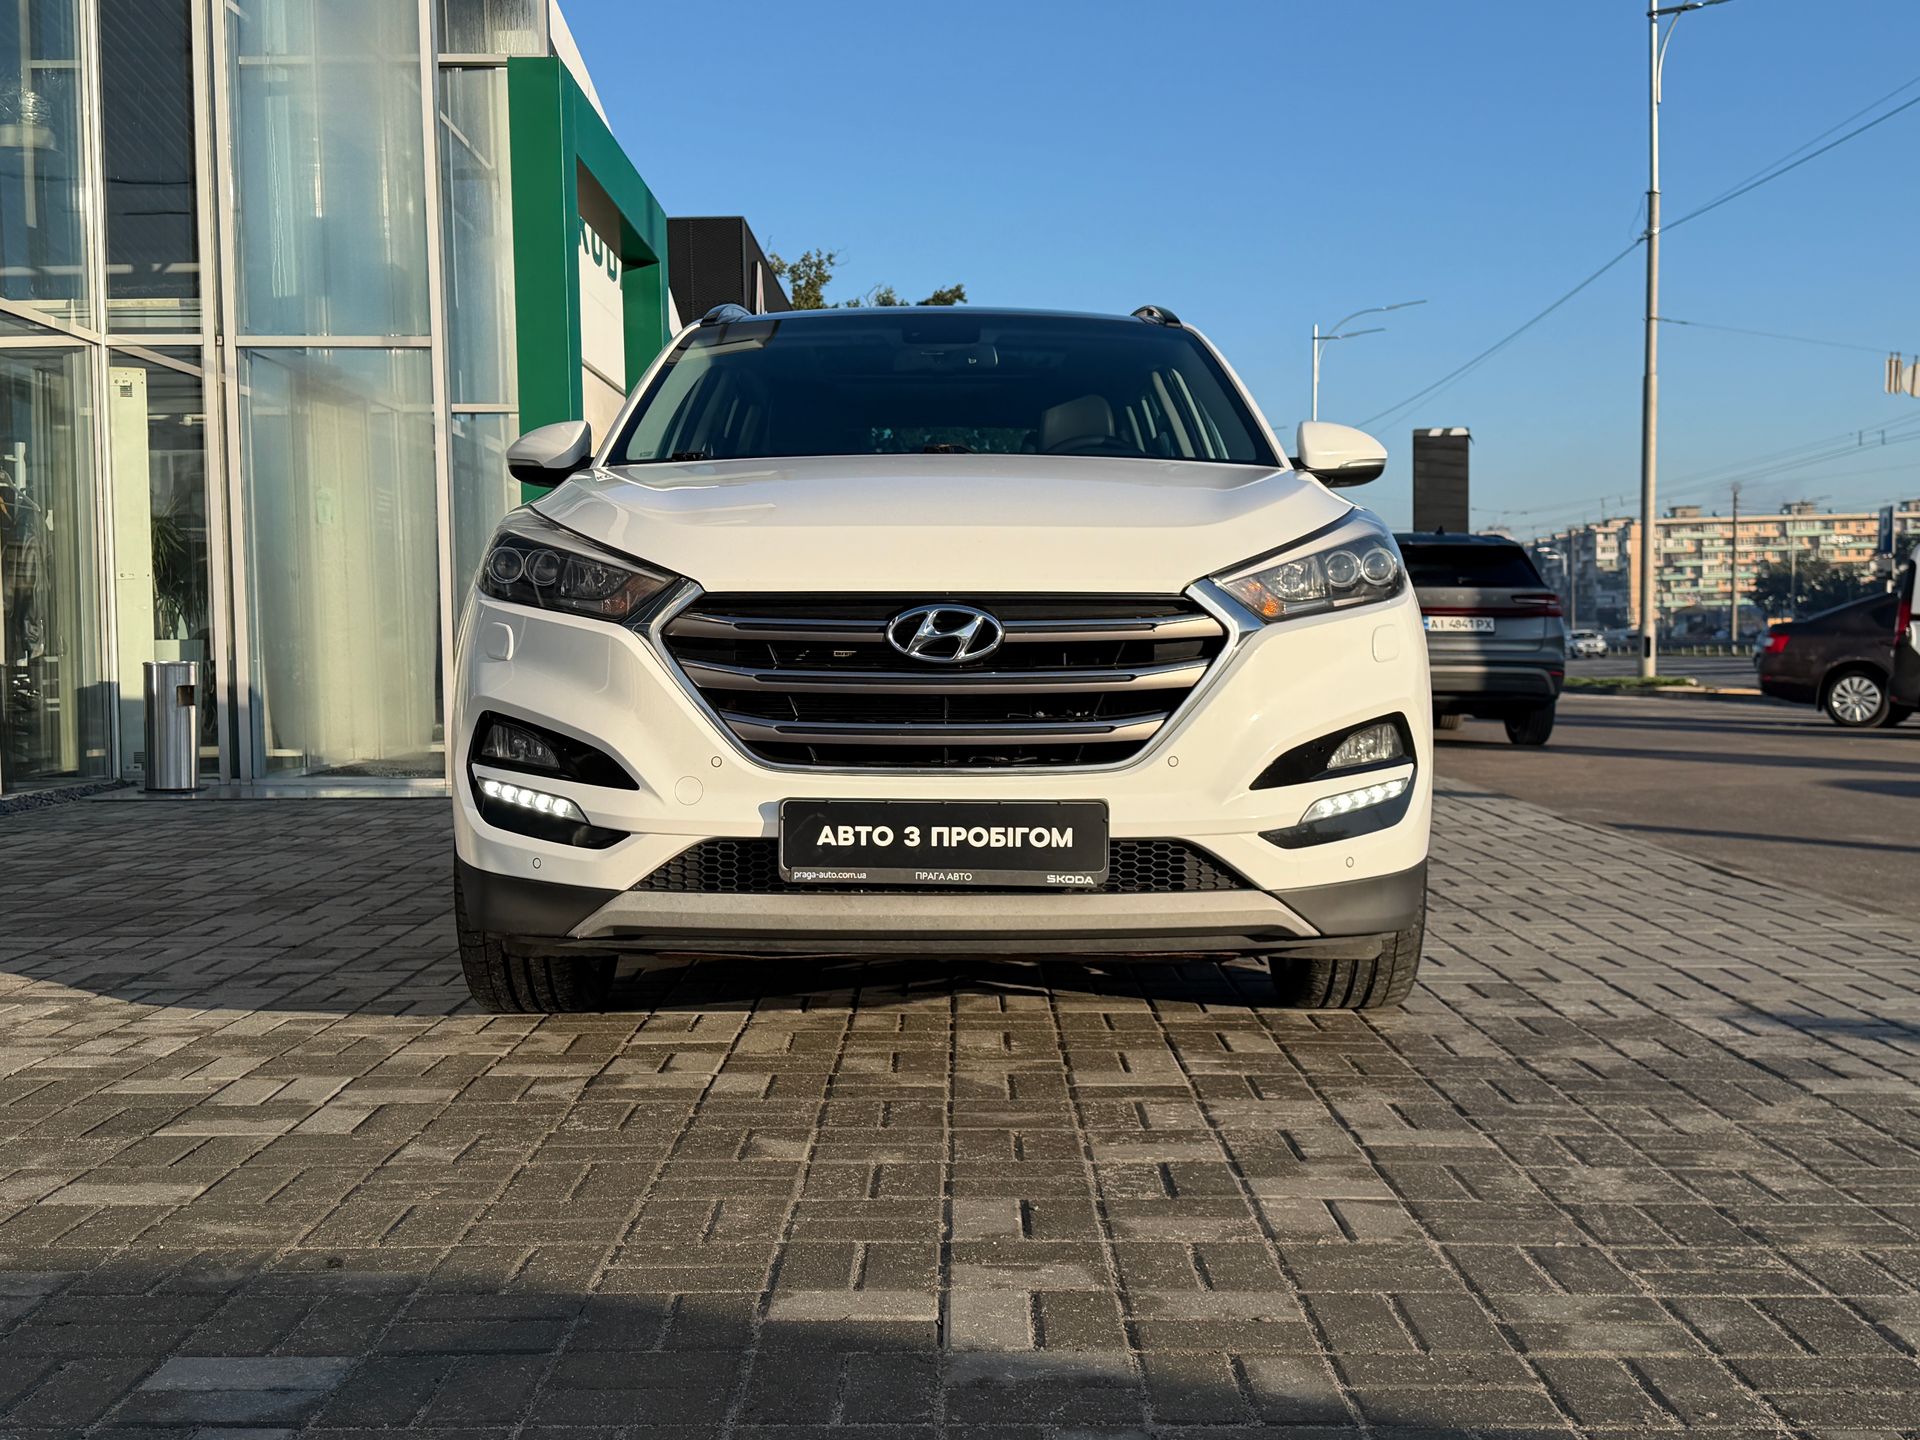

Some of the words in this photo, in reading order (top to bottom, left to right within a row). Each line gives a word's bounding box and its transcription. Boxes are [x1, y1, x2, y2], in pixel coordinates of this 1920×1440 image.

[816, 825, 894, 847] АВТО
[931, 826, 1073, 848] ПРОБІГОМ
[793, 871, 867, 880] praga-auto.com.ua
[915, 871, 946, 881] ПРАГА
[947, 872, 973, 881] АВТО
